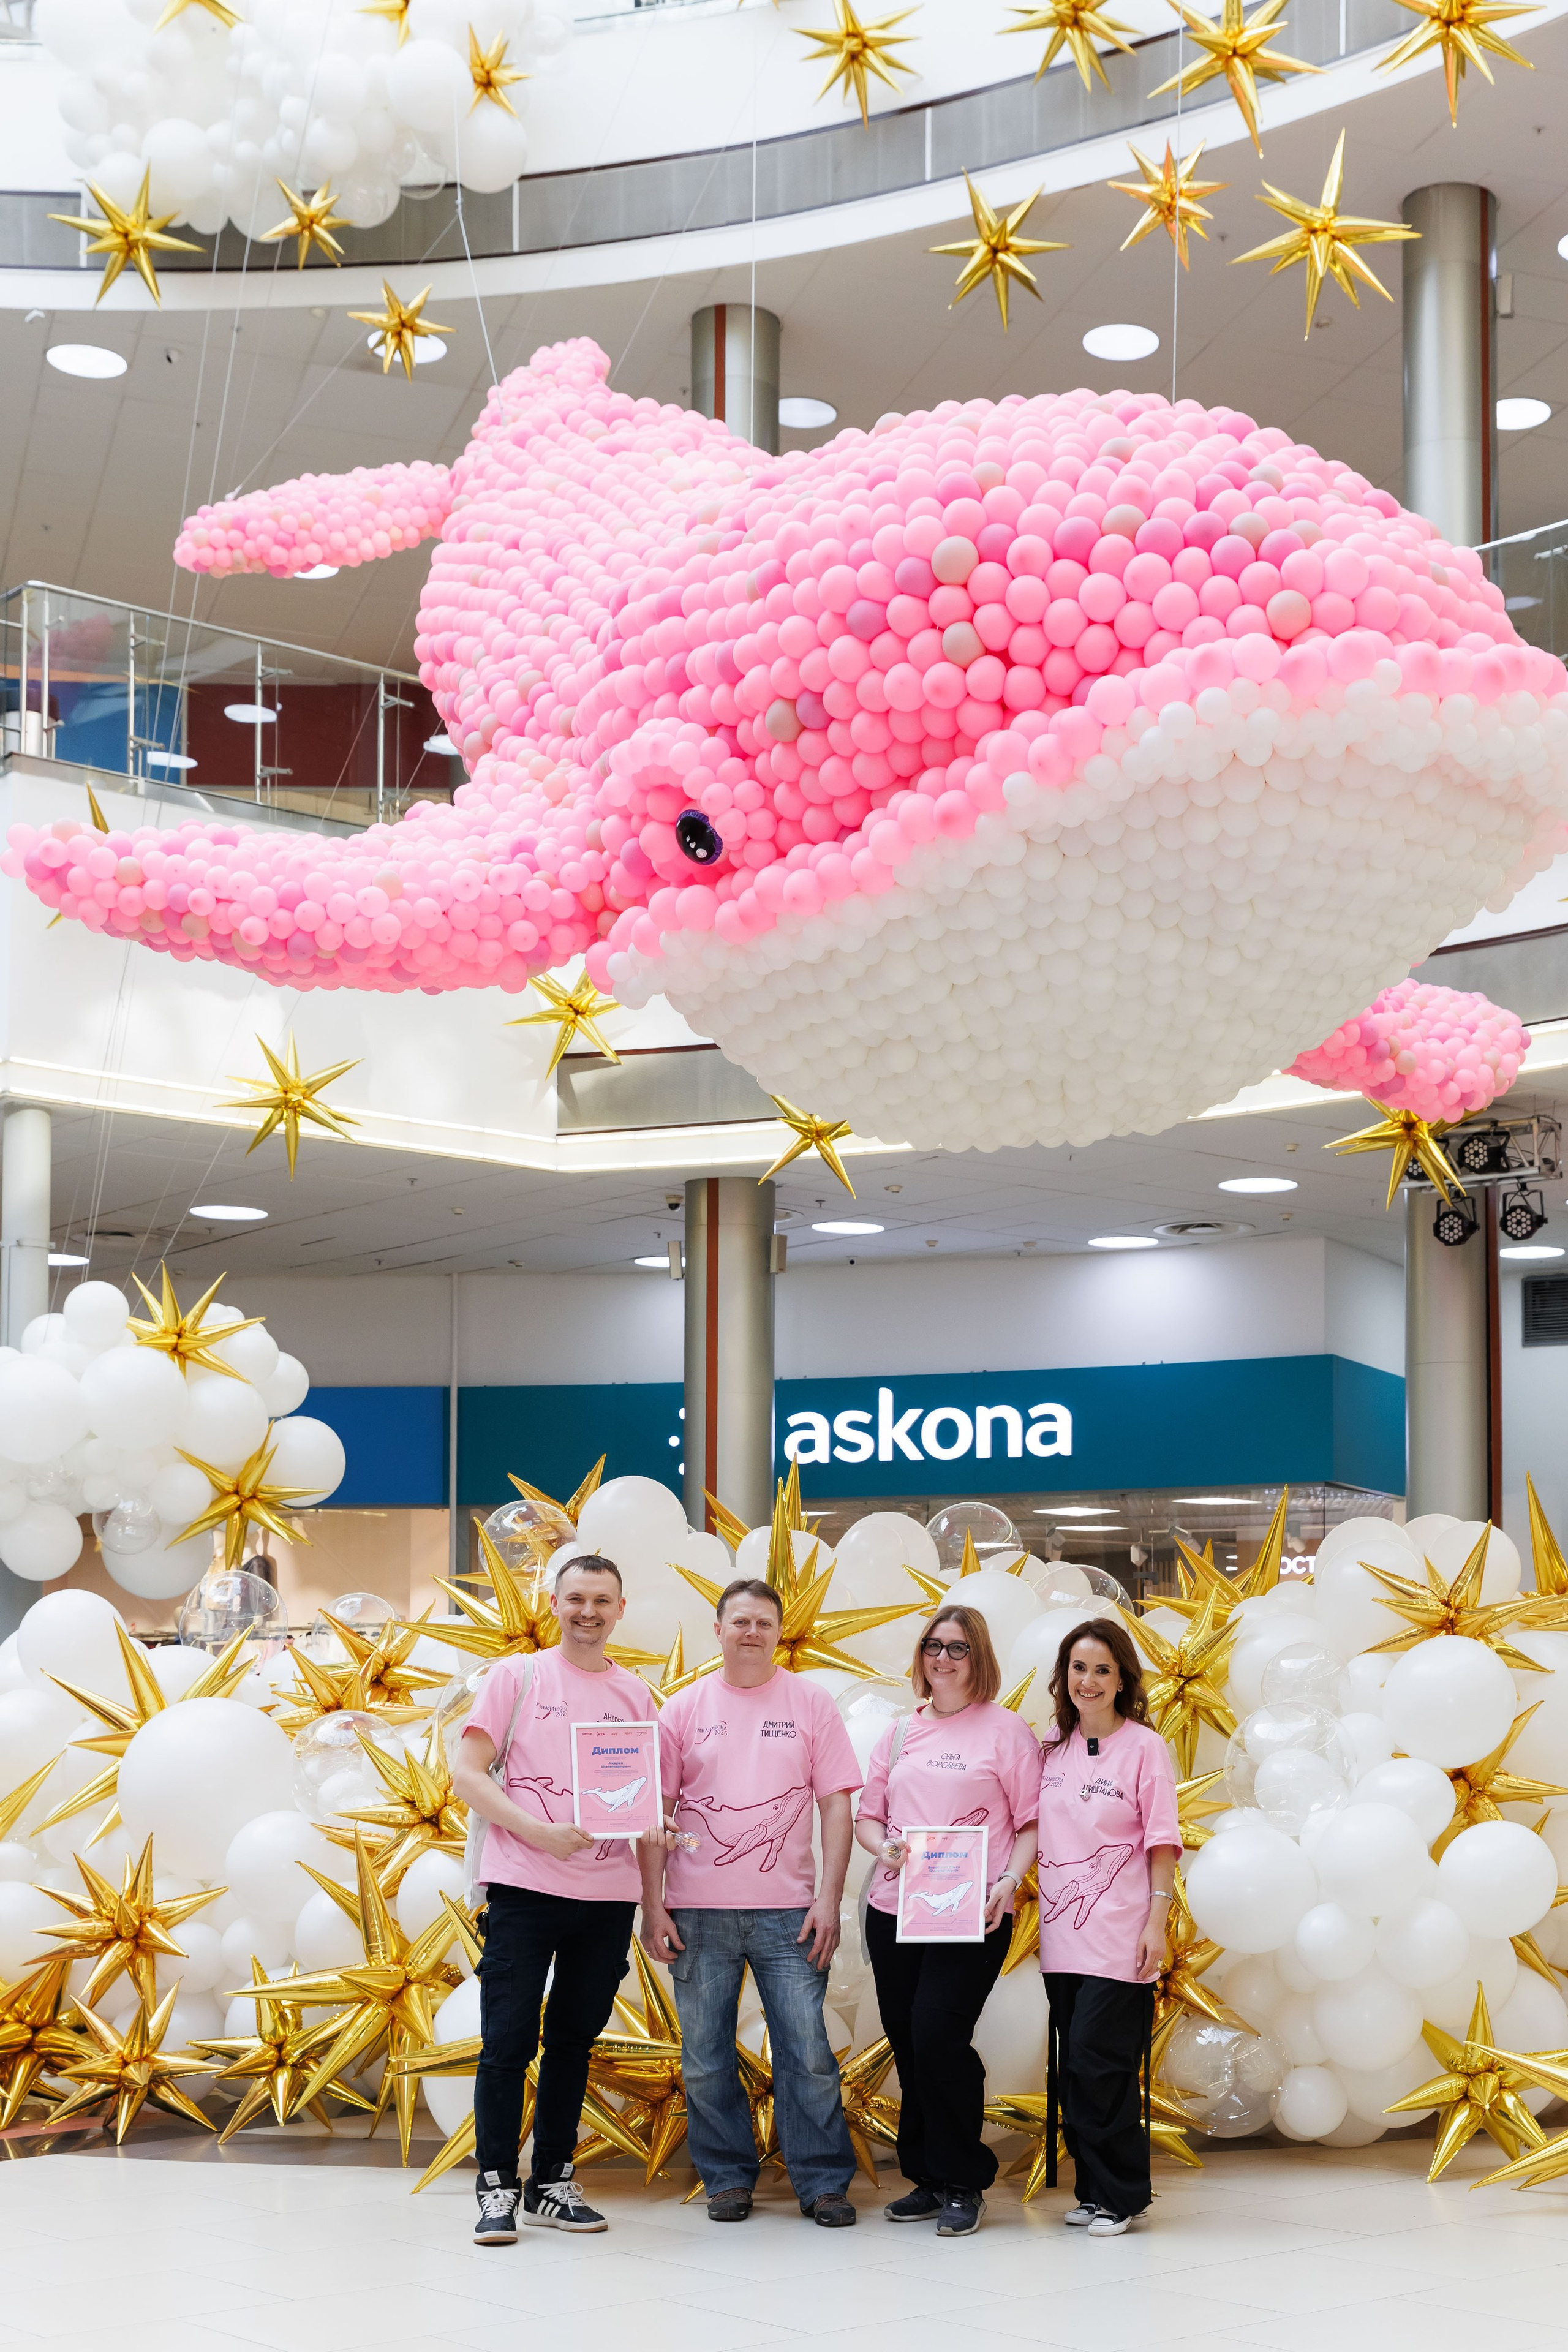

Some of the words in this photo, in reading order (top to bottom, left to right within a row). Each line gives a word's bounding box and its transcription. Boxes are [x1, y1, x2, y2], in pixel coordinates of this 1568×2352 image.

[783, 1387, 1073, 1464] askona
[763, 1720, 794, 1728] ДМИТРИЙ
[761, 1730, 797, 1738] ТИЩЕНКО
[592, 1746, 639, 1755] Диплом
[926, 1760, 967, 1771] ВОРОБЬЕВА
[1095, 1777, 1114, 1787] ДИНА
[921, 1851, 968, 1860] Диплом
